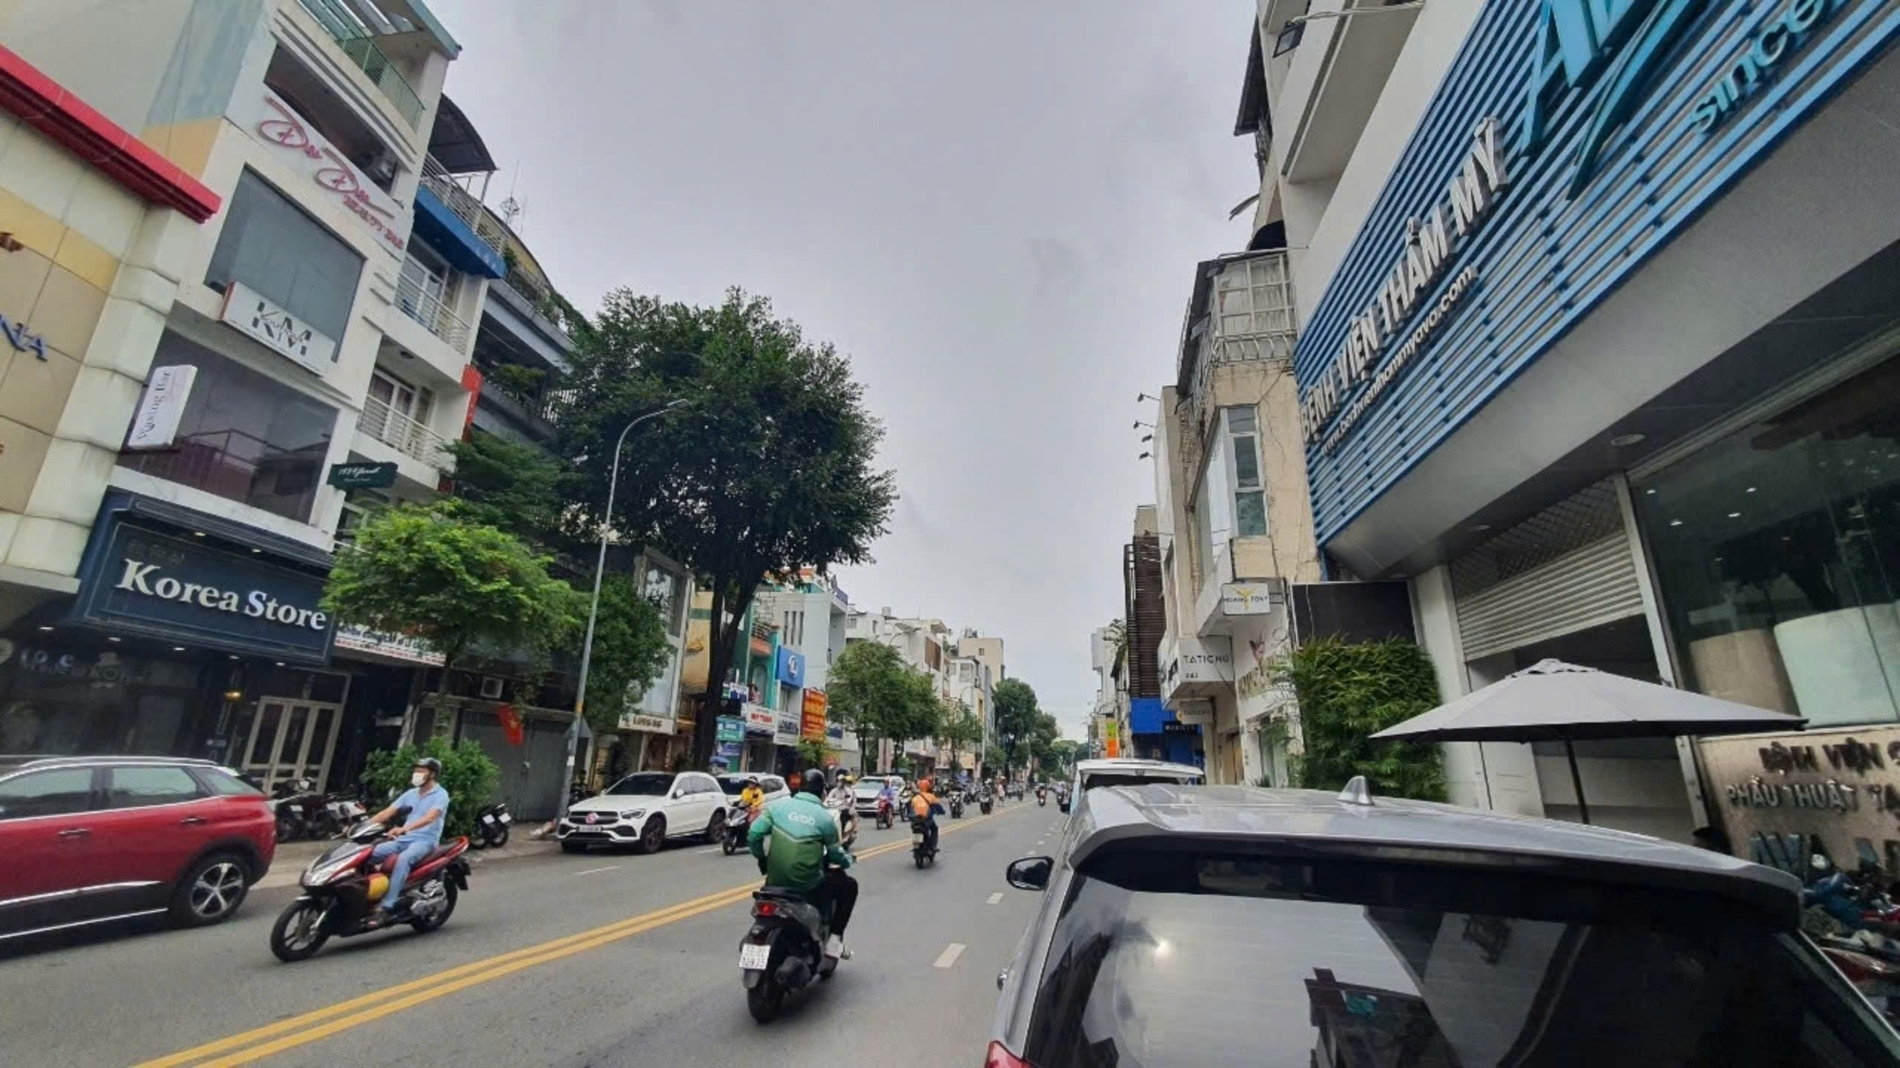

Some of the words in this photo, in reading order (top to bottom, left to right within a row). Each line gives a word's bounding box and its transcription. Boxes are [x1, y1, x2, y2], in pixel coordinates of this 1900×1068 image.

[115, 558, 240, 613] Korea
[244, 589, 328, 631] Store
[788, 811, 816, 826] Grab
